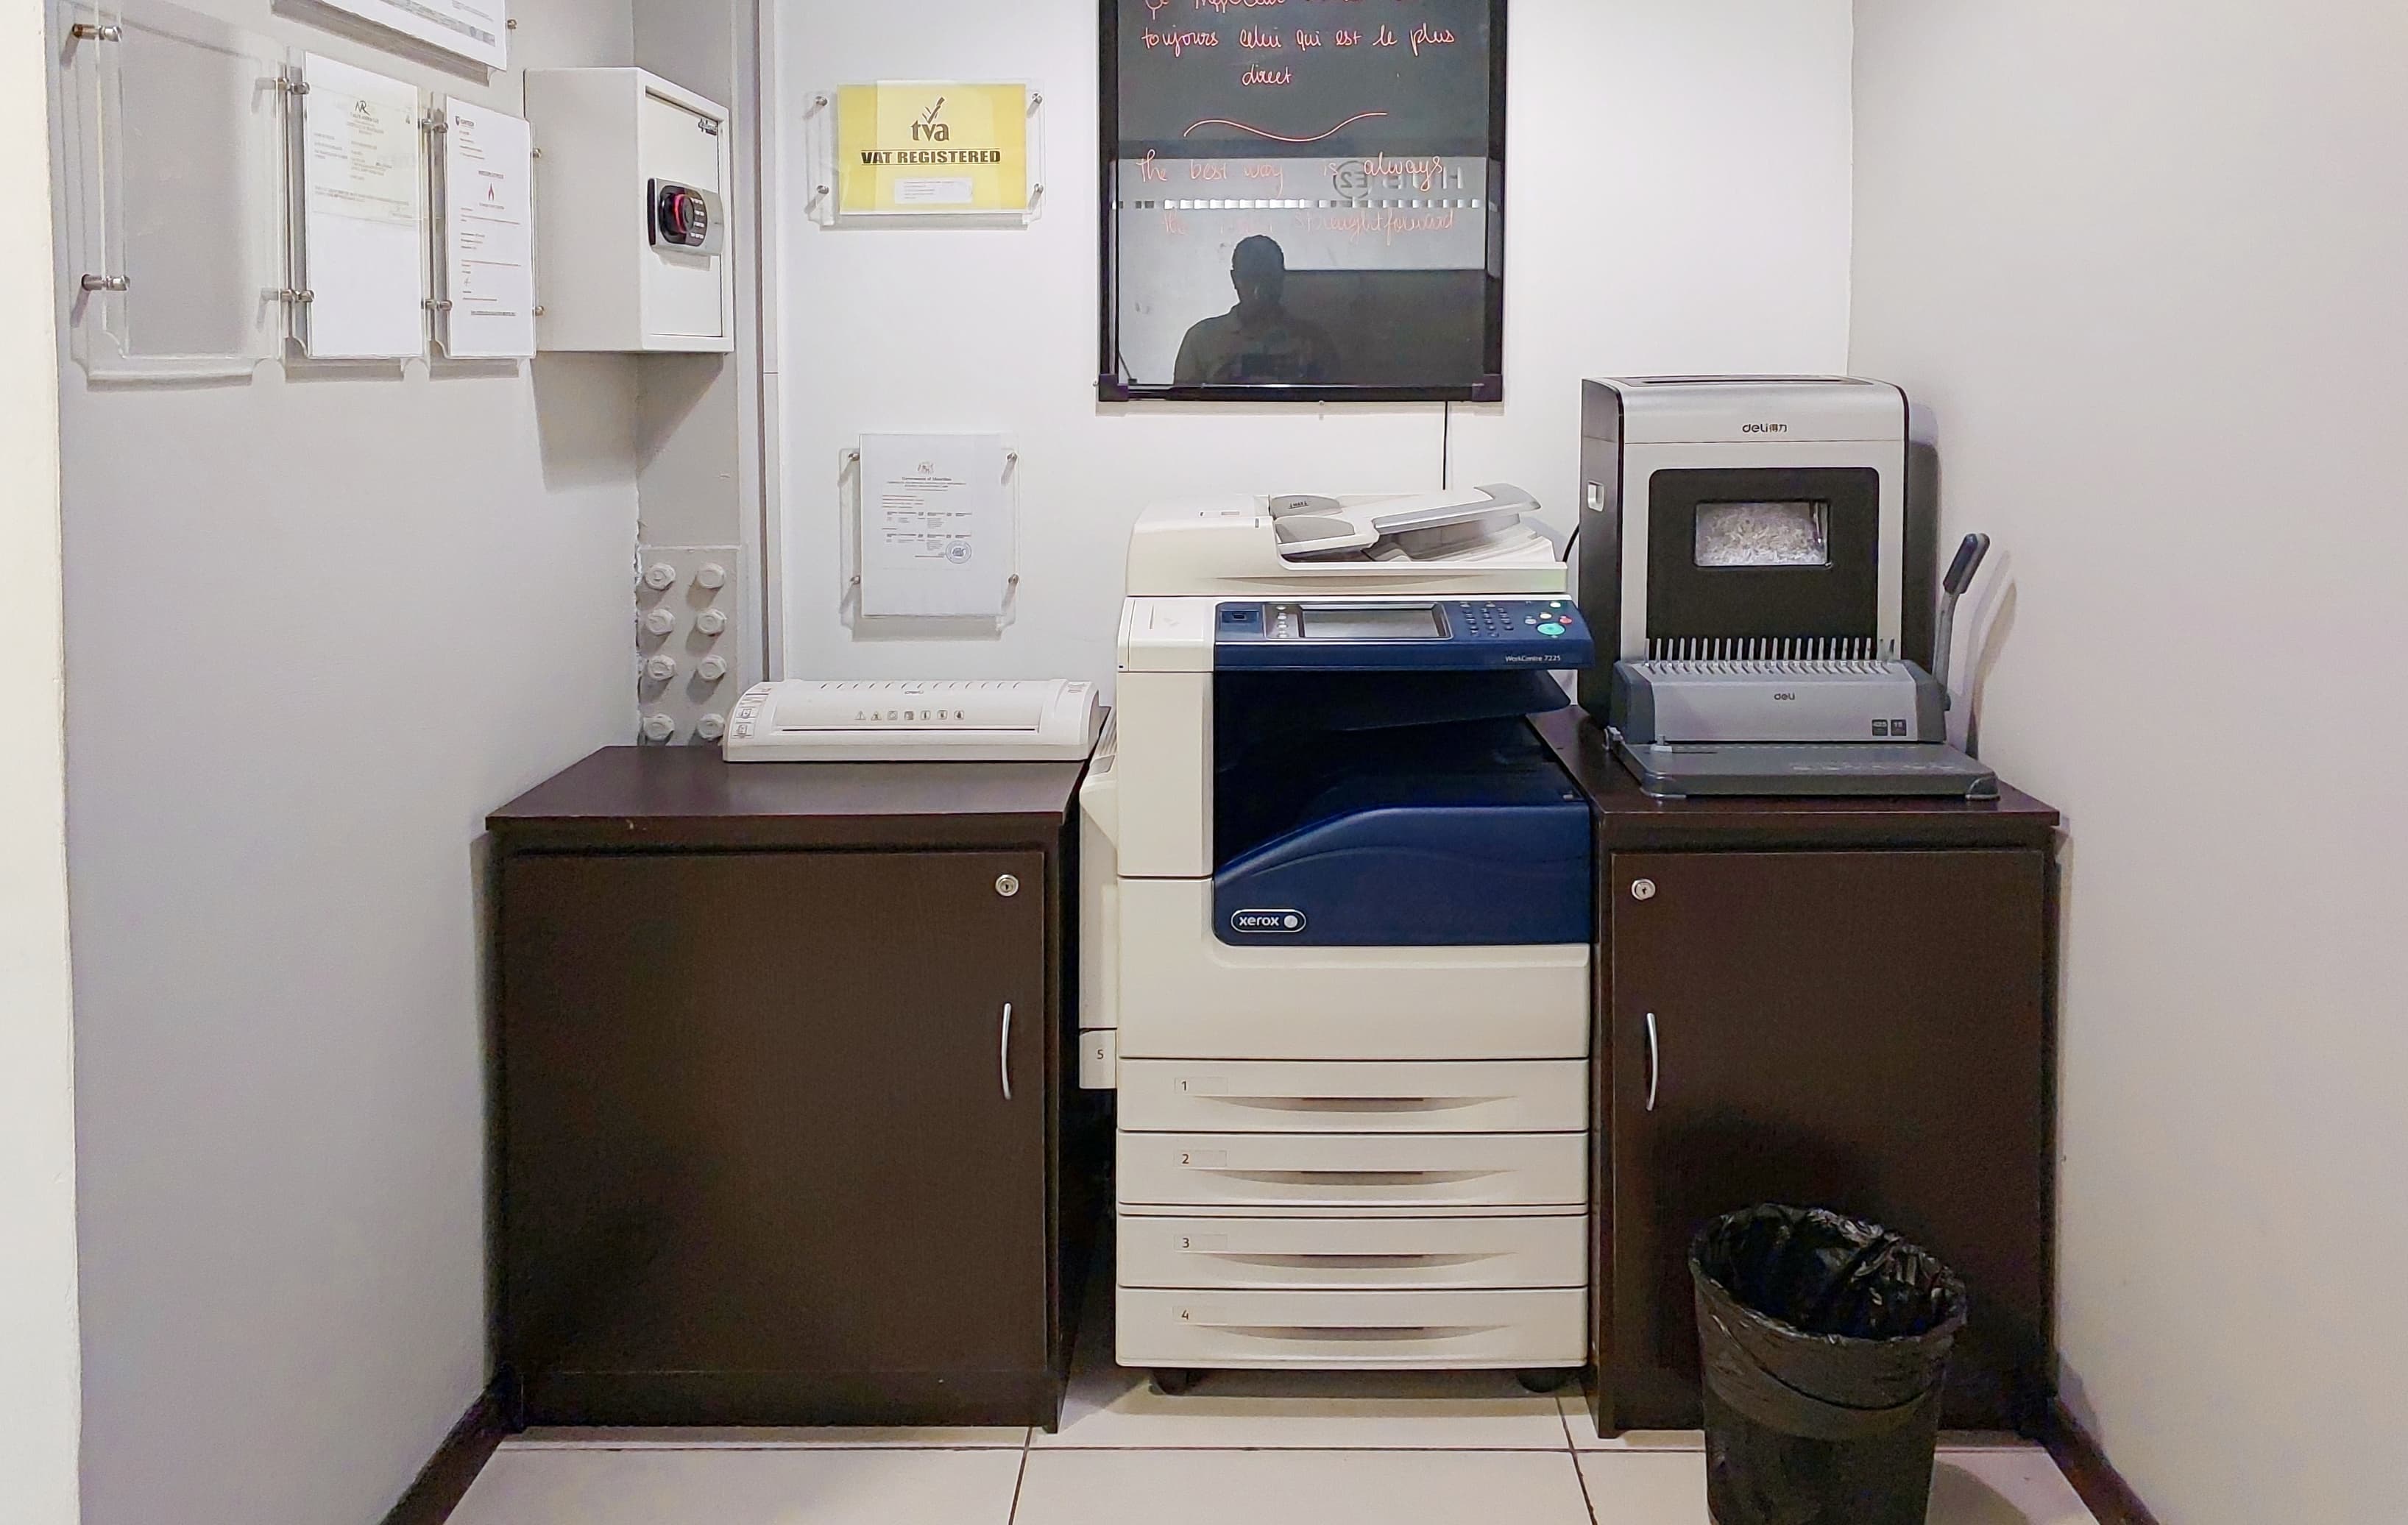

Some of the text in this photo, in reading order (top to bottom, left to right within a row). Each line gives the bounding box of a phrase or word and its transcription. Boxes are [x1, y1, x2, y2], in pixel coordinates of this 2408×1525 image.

[1141, 23, 1455, 57] toujours celui qui est le plus
[1242, 63, 1292, 85] direct
[910, 121, 950, 141] tva
[861, 150, 1001, 164] VAT REGISTERED
[1190, 158, 1228, 180] best
[1243, 163, 1283, 199] way
[1323, 160, 1339, 177] is
[1364, 152, 1444, 191] always
[1239, 916, 1280, 927] xerox
[1097, 1049, 1105, 1060] 5
[1181, 1080, 1188, 1091] 1
[1181, 1153, 1190, 1164] 2
[1182, 1237, 1191, 1248] 3
[1180, 1309, 1189, 1320] 4
